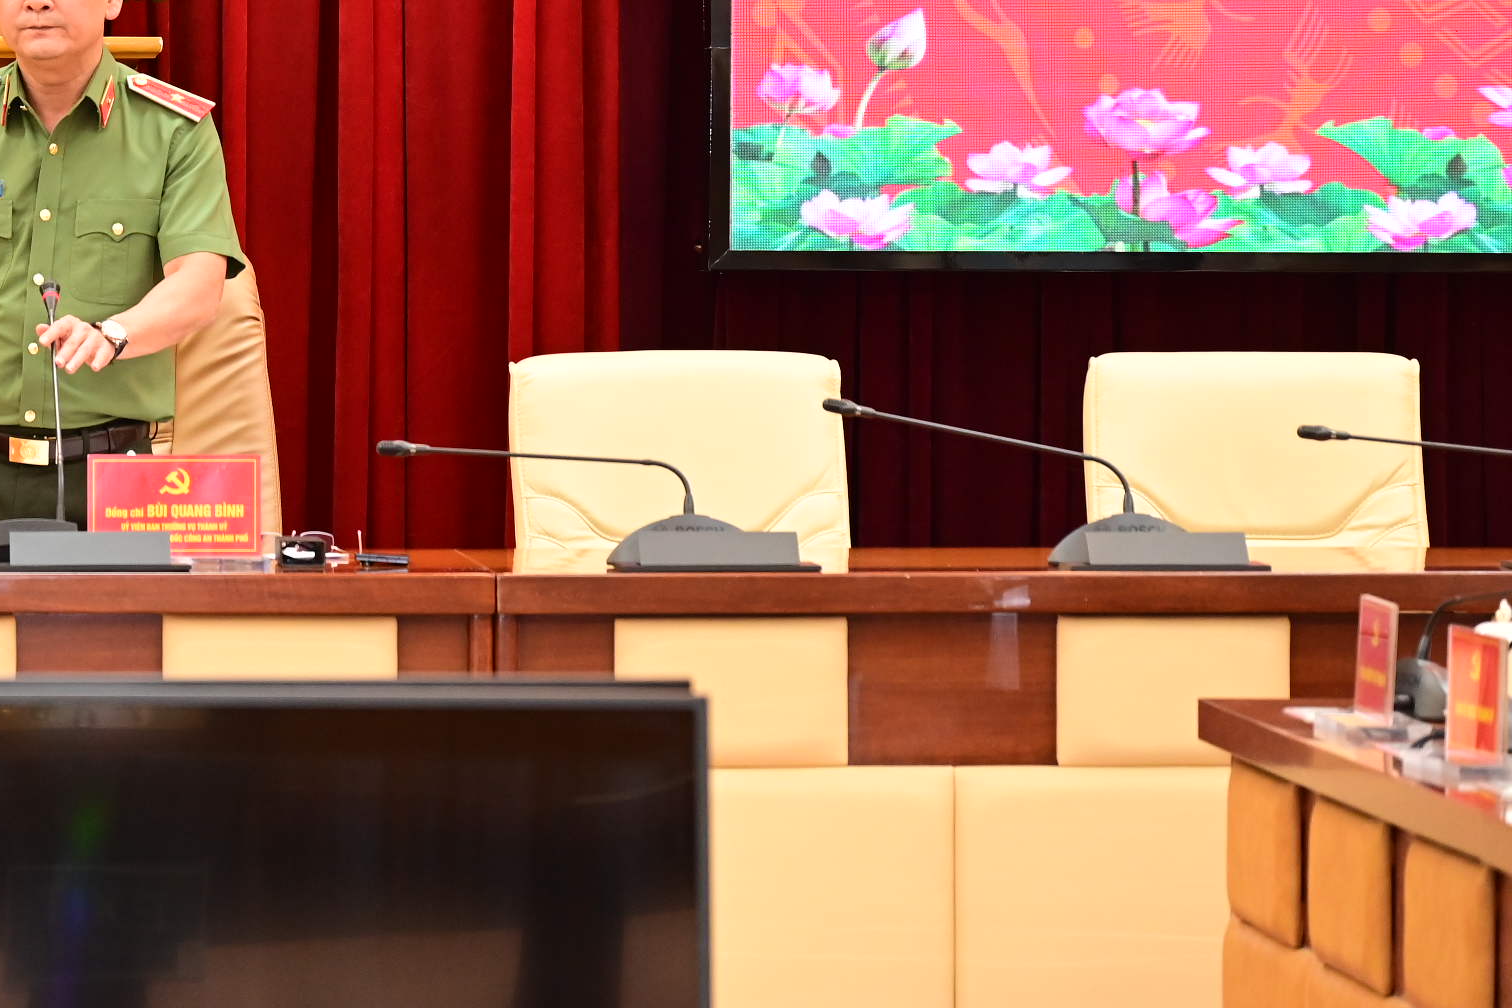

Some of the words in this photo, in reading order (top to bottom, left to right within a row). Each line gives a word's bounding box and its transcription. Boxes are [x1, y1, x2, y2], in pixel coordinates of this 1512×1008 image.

[147, 502, 168, 518] BÙI
[171, 503, 212, 519] QUANG
[215, 502, 244, 518] BÌNH
